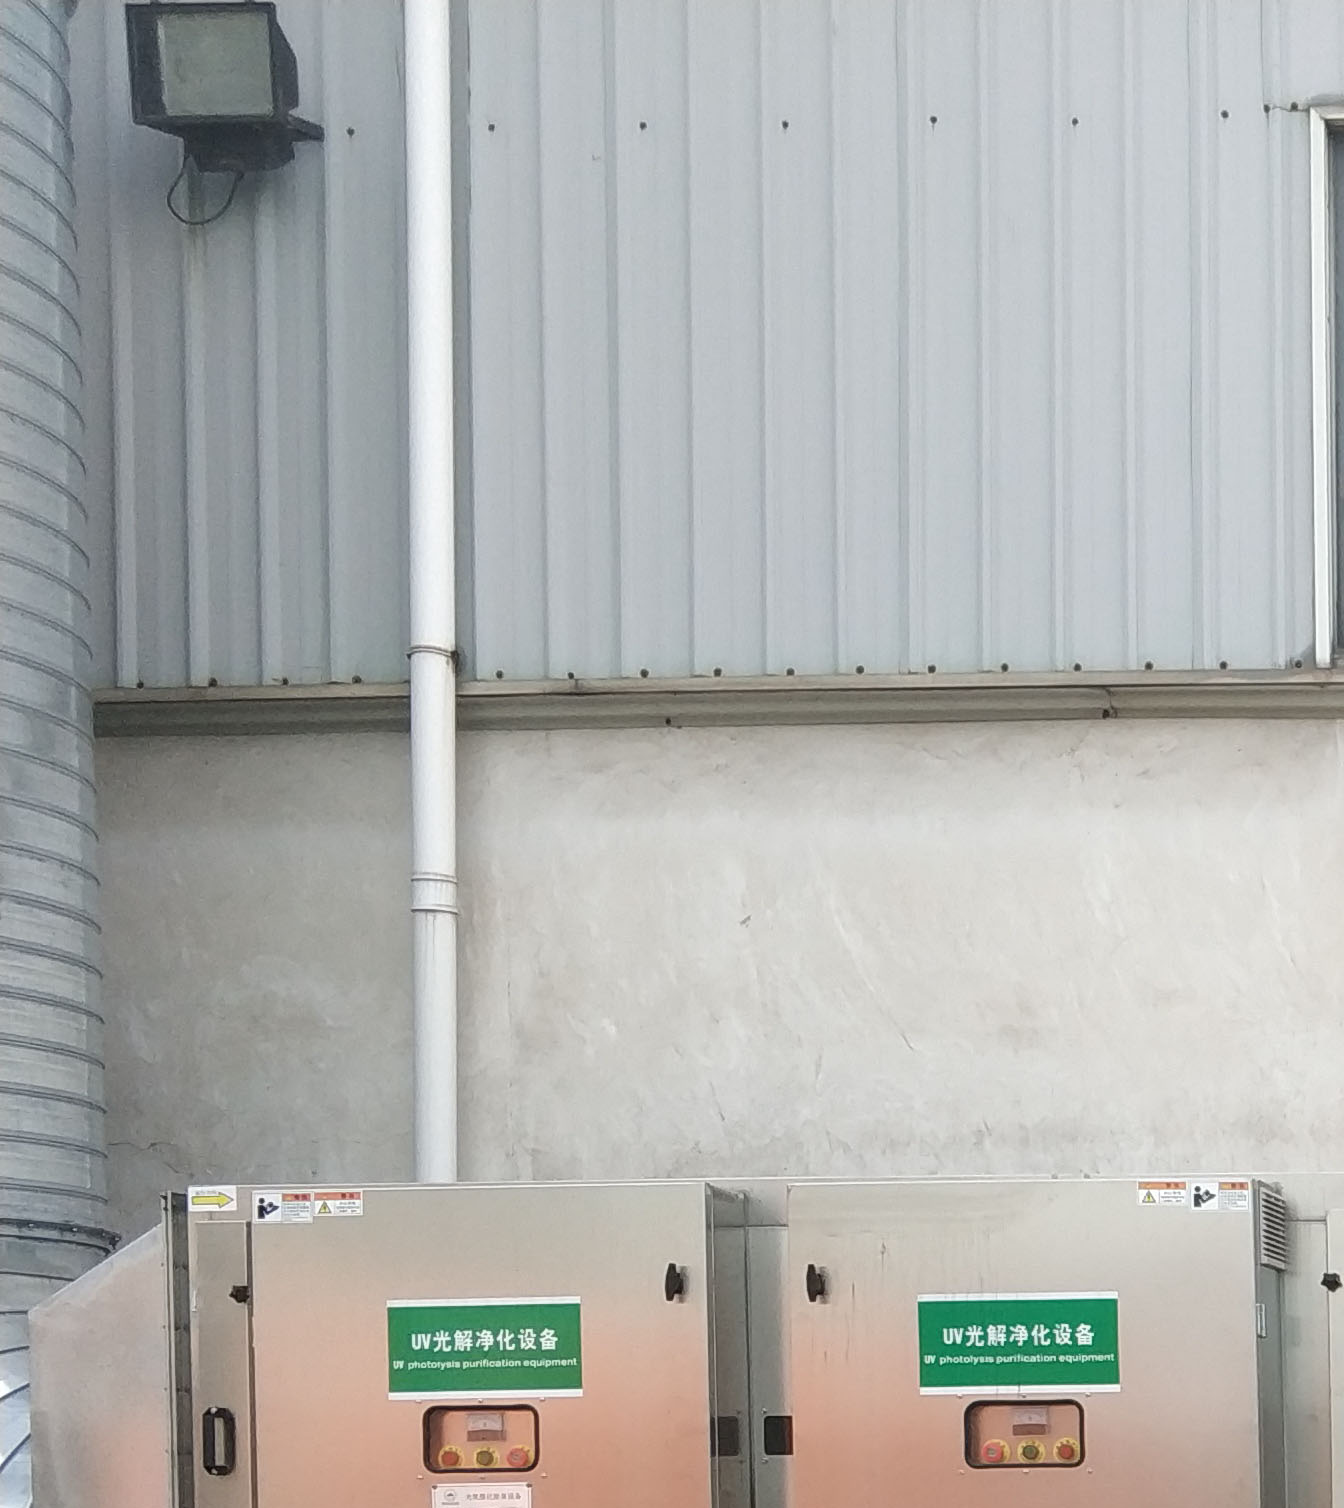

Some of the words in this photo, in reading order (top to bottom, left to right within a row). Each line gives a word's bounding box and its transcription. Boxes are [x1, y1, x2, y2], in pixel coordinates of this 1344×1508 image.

[411, 1328, 558, 1352] UV光解净化设备
[943, 1324, 1094, 1346] UV光解净化设备
[393, 1360, 404, 1369] UV
[523, 1358, 577, 1367] equipment
[924, 1355, 936, 1364] UV
[1058, 1354, 1114, 1363] equipment
